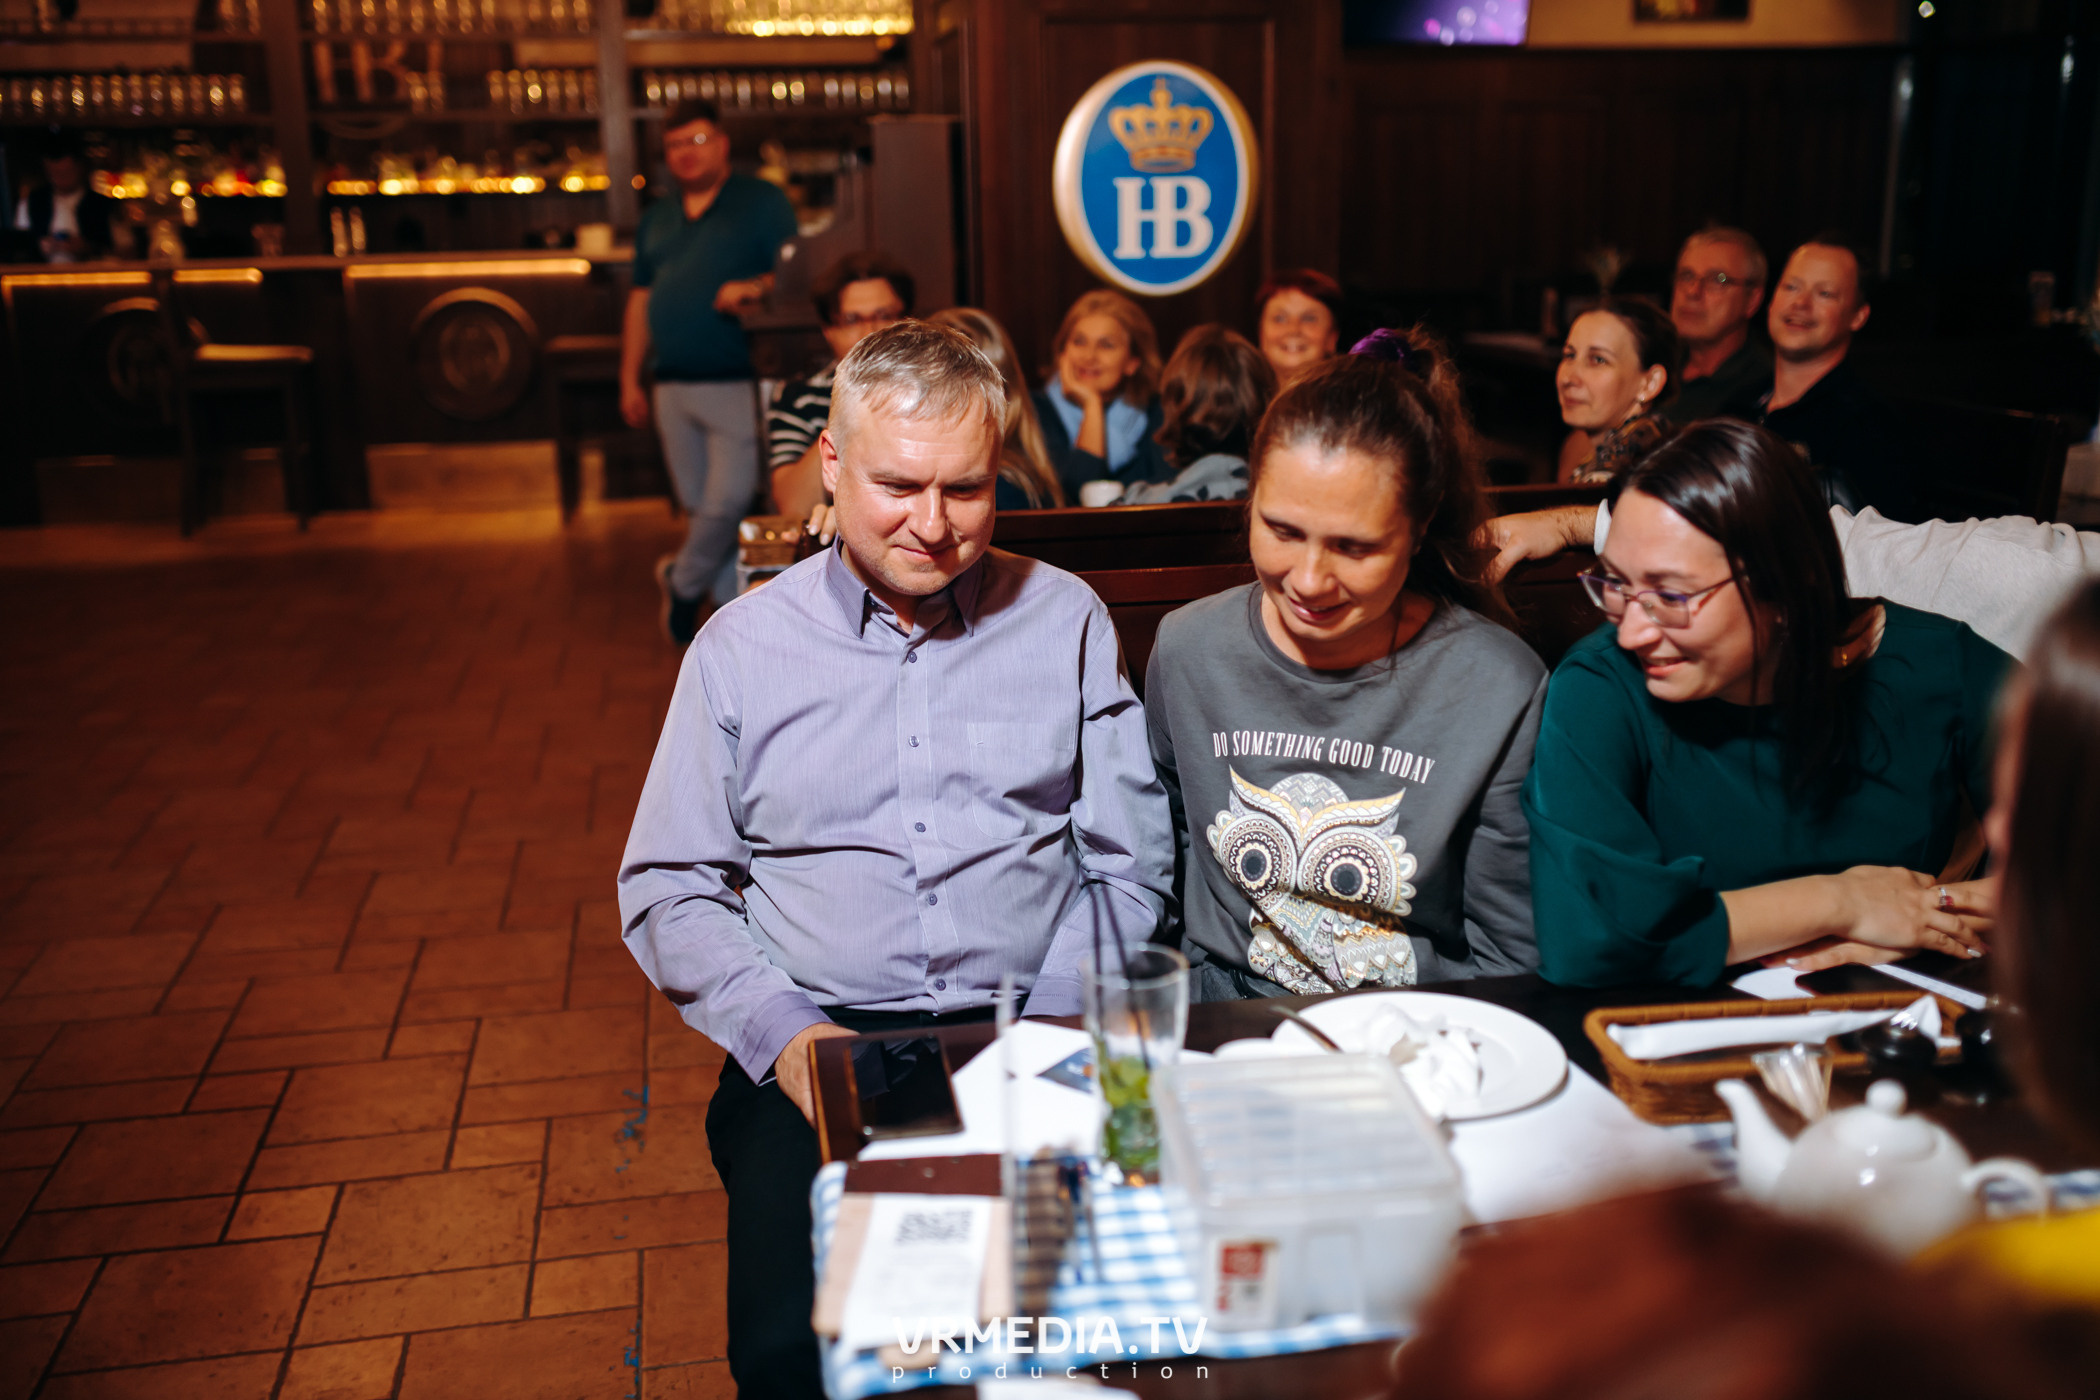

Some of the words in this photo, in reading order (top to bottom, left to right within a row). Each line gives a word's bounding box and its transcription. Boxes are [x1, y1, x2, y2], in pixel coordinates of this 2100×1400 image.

[1112, 175, 1214, 260] HB
[1212, 731, 1229, 758] DO
[1232, 730, 1326, 762] SOMETHING
[1328, 737, 1375, 769] GOOD
[1380, 746, 1436, 784] TODAY
